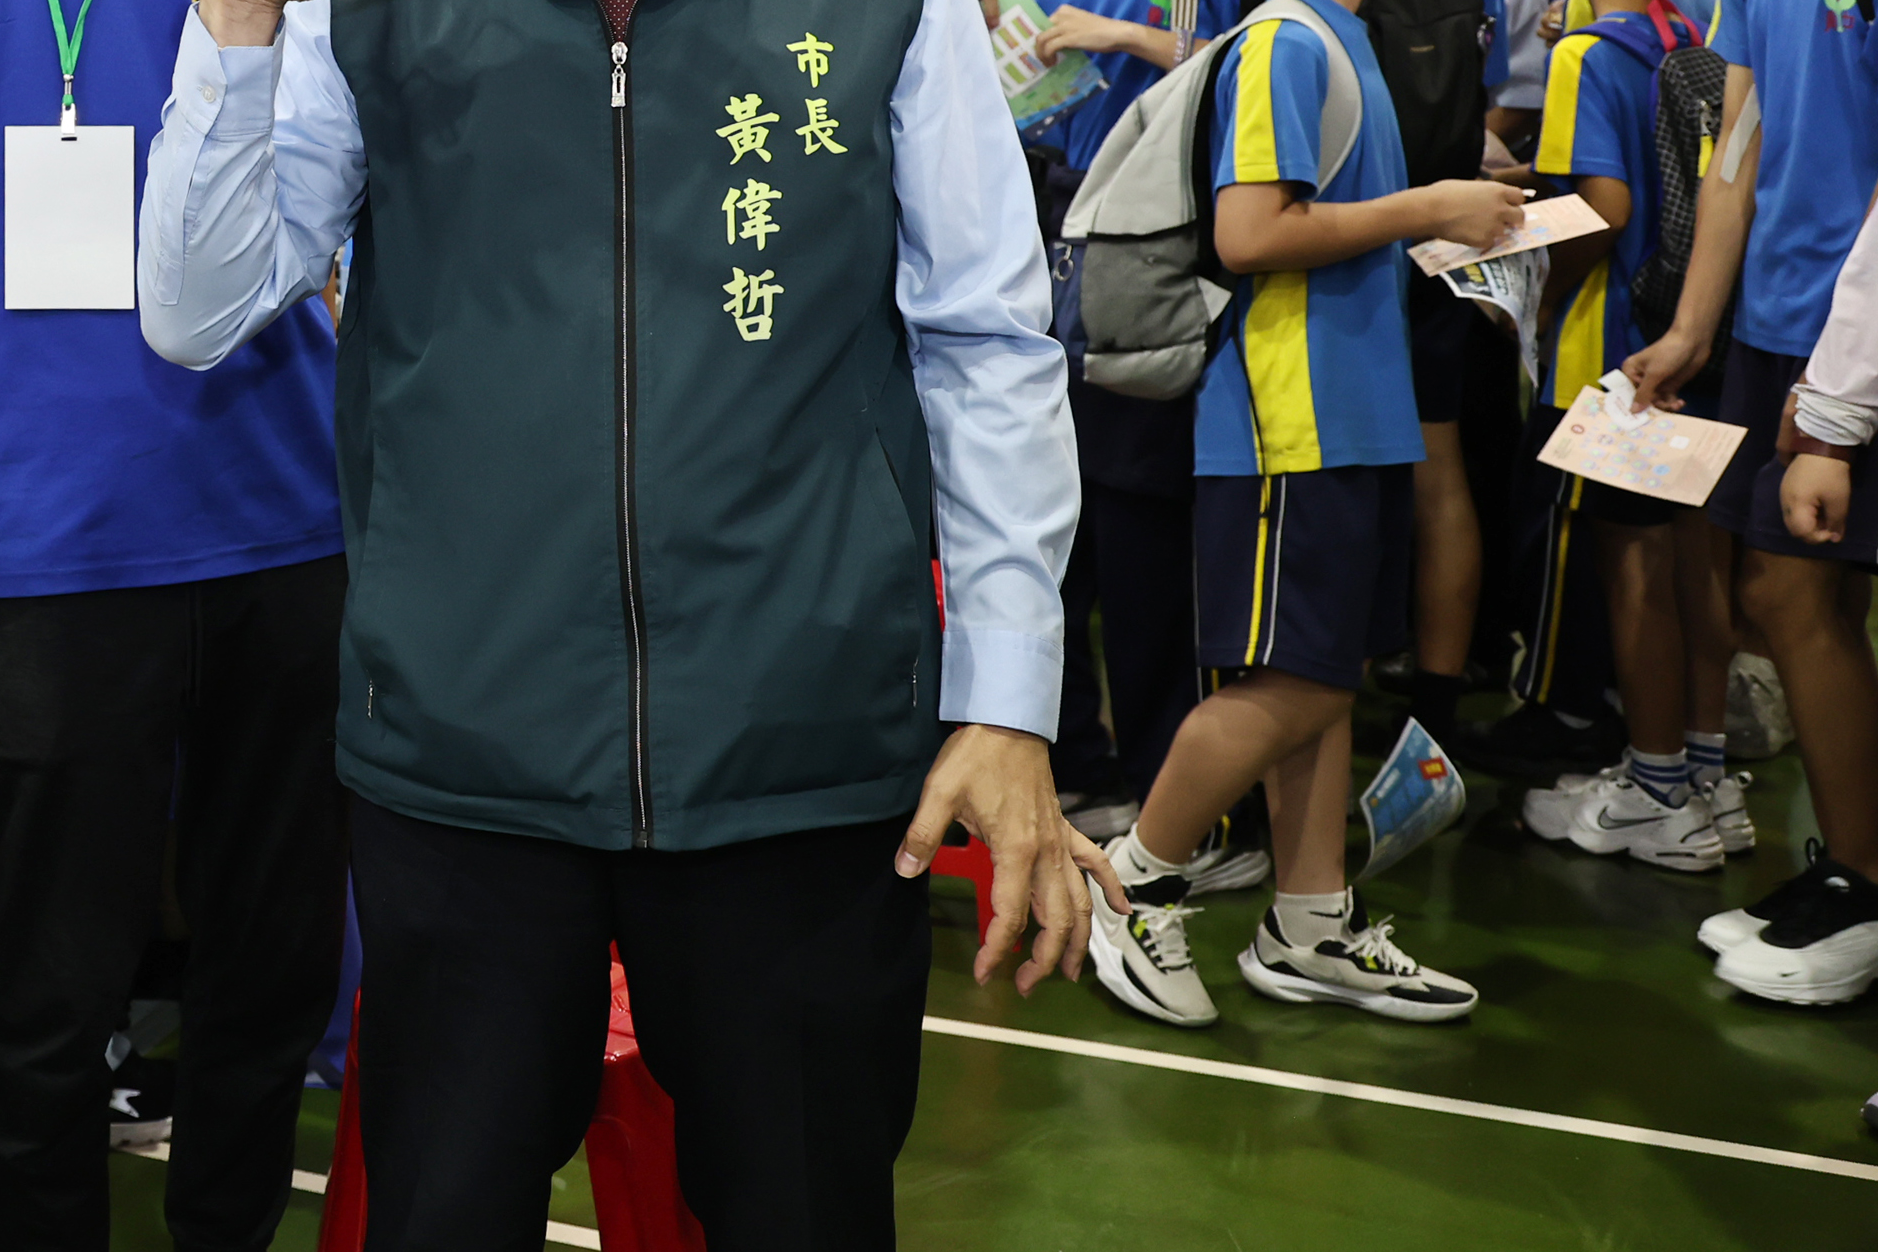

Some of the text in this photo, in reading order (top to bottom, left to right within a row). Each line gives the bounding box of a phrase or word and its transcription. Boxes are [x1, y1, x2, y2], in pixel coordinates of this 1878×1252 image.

[785, 31, 849, 156] 市長
[715, 93, 785, 342] 黃偉哲
